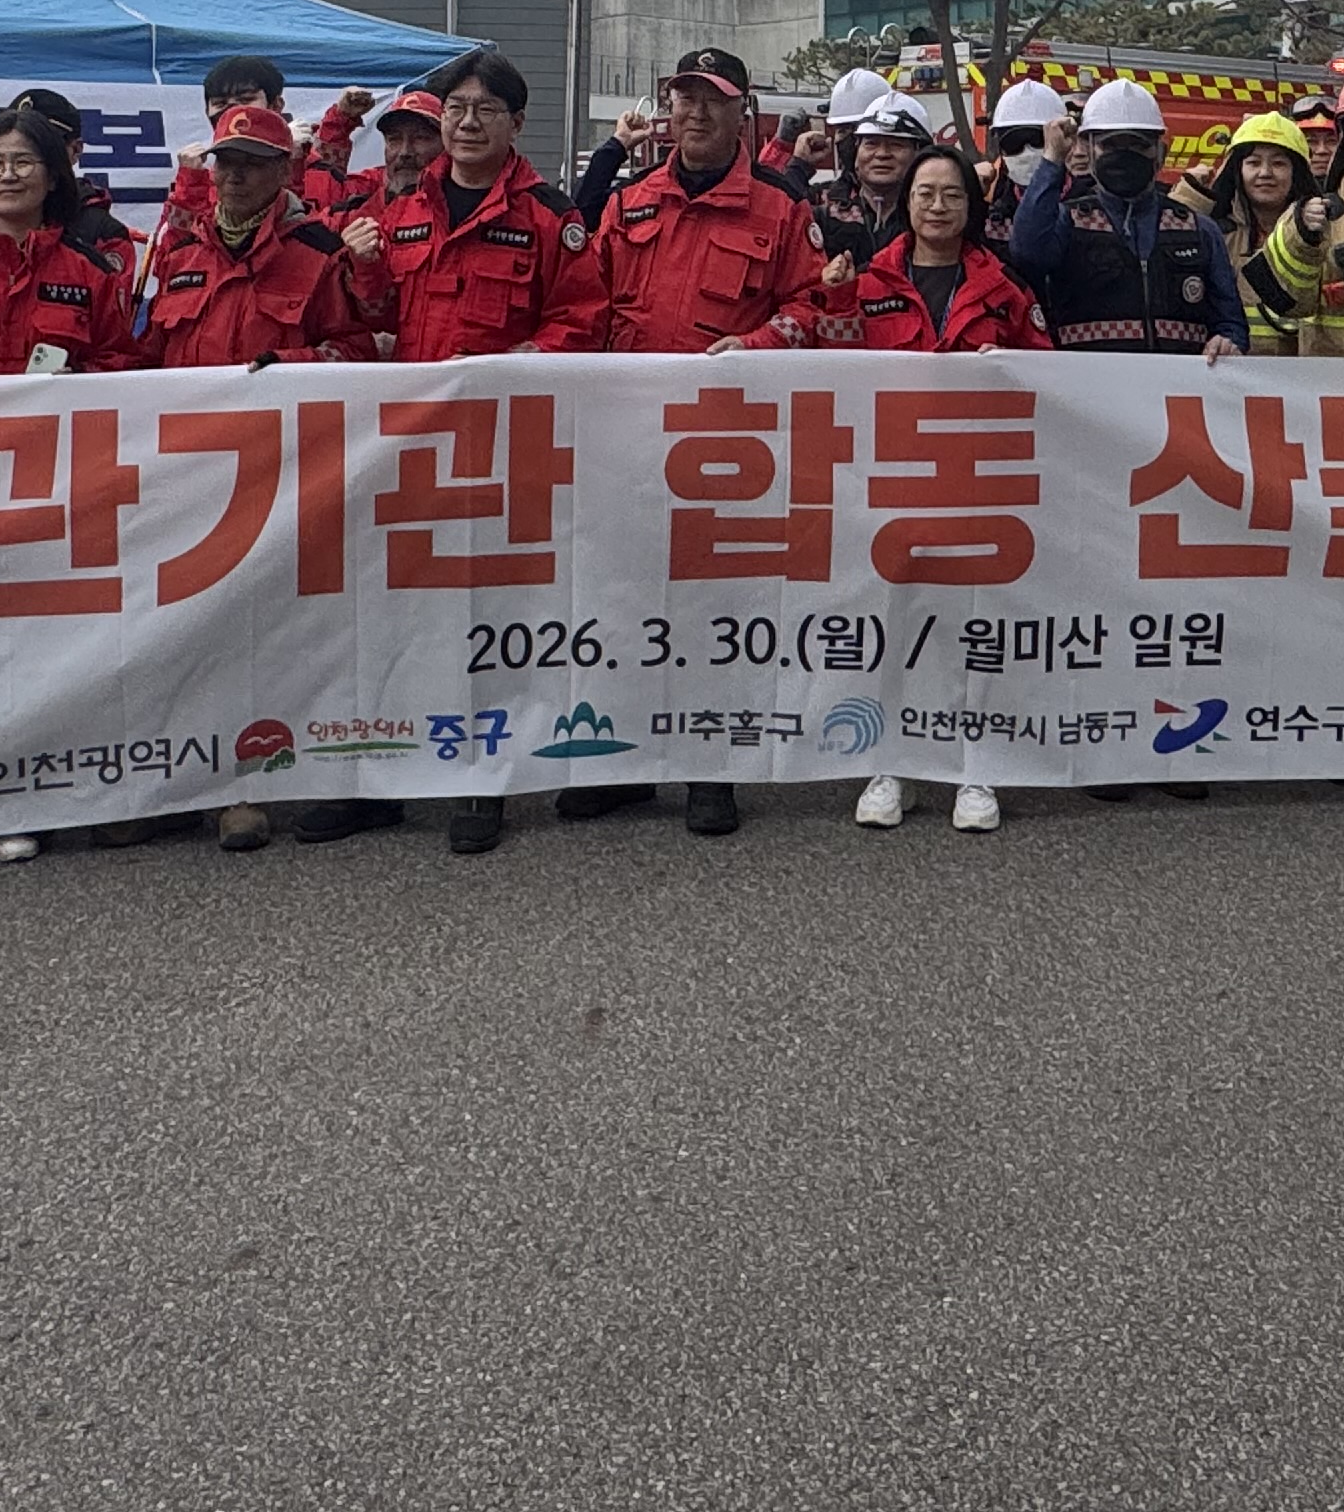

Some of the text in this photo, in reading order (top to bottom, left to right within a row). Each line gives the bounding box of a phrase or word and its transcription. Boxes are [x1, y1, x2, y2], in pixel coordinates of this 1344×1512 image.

[663, 387, 1040, 585] 합동
[467, 619, 617, 674] 2026.
[640, 618, 686, 668] 3.
[709, 614, 886, 672] 30.(월)
[959, 614, 1108, 673] 월미산
[1130, 613, 1225, 668] 일원
[307, 709, 513, 760] 인천광역시 중구
[651, 709, 805, 747] 미추홀구
[901, 707, 1137, 746] 인천광역시 남동구
